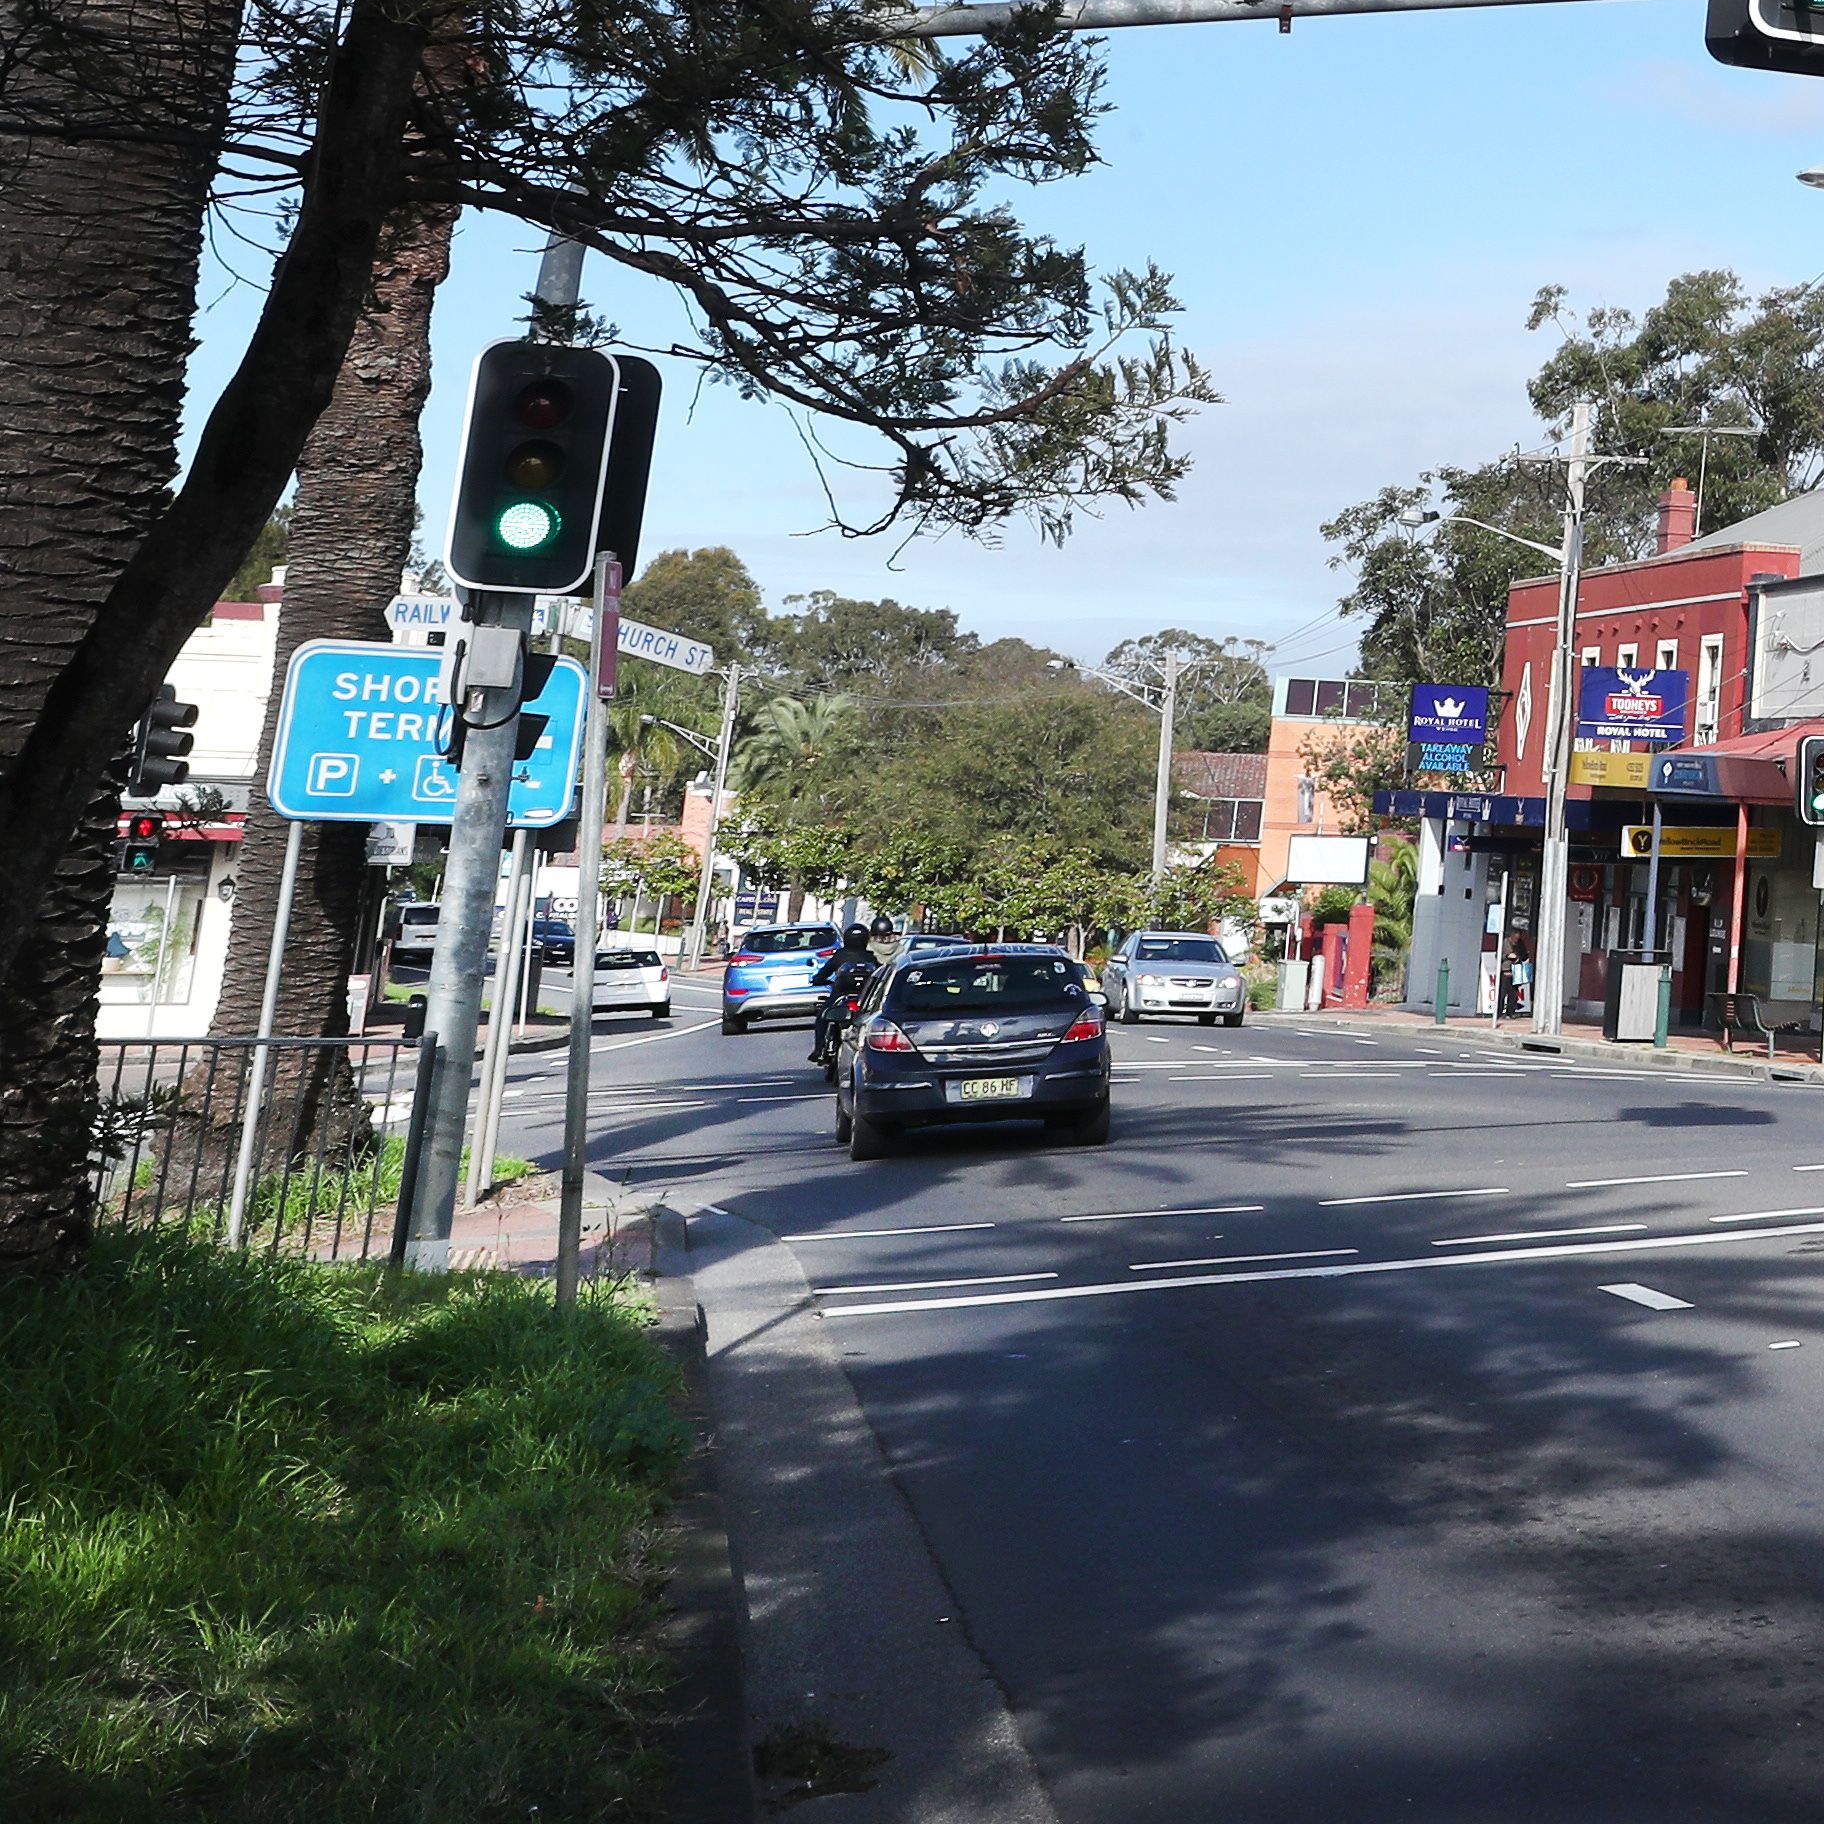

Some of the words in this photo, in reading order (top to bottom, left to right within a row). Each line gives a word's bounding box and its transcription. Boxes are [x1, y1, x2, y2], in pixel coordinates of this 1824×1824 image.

[616, 627, 678, 664] HURCH
[684, 642, 709, 666] ST
[1611, 697, 1658, 712] TOOHEYS
[1413, 715, 1446, 727] ROYAL
[1448, 718, 1482, 730] HOTEL
[1596, 726, 1631, 737] ROYAL
[1633, 727, 1668, 739] HOTEL
[1420, 743, 1474, 755] TAKEAWAY
[1421, 752, 1469, 763] ALCOHOL
[1418, 761, 1470, 772] AVAILABLE
[316, 759, 349, 791] P
[982, 1079, 998, 1094] 86
